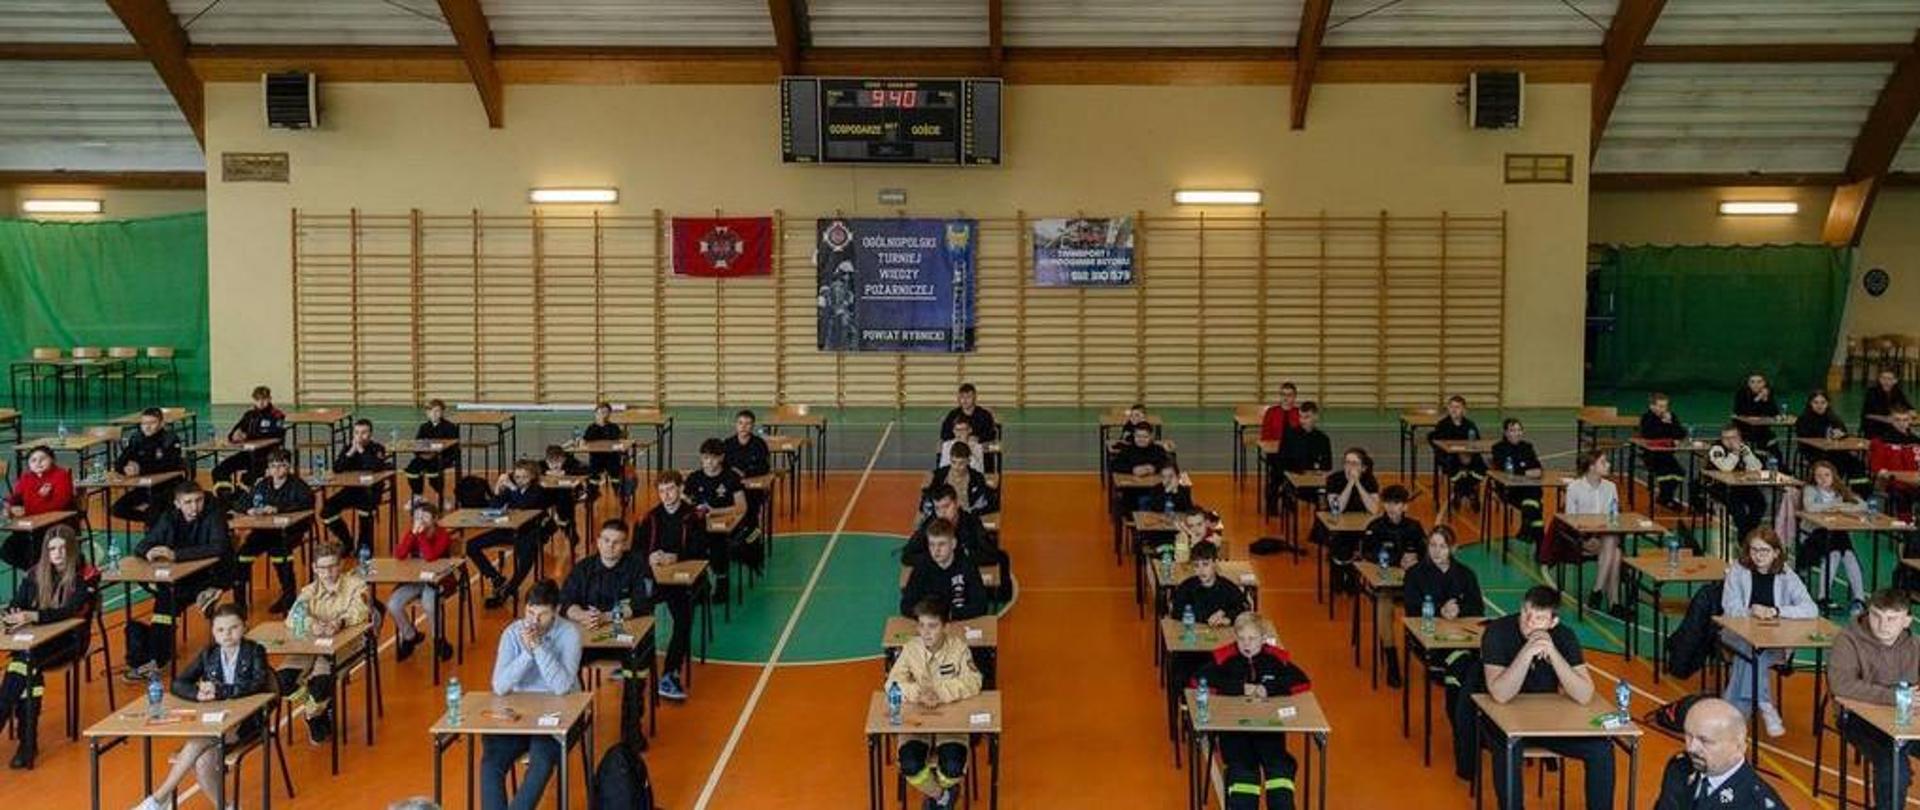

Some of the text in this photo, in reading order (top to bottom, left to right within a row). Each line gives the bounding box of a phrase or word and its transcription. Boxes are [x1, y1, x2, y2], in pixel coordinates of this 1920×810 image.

[911, 122, 941, 136] GOŚCIE
[862, 235, 937, 249] OGÓLNOPOLSKI
[877, 252, 922, 264] TURNIEJ
[879, 268, 920, 280] WIEDZY
[864, 284, 935, 296] POŻARNICZEJ
[862, 330, 945, 342] POWIAT RYBNICKI
